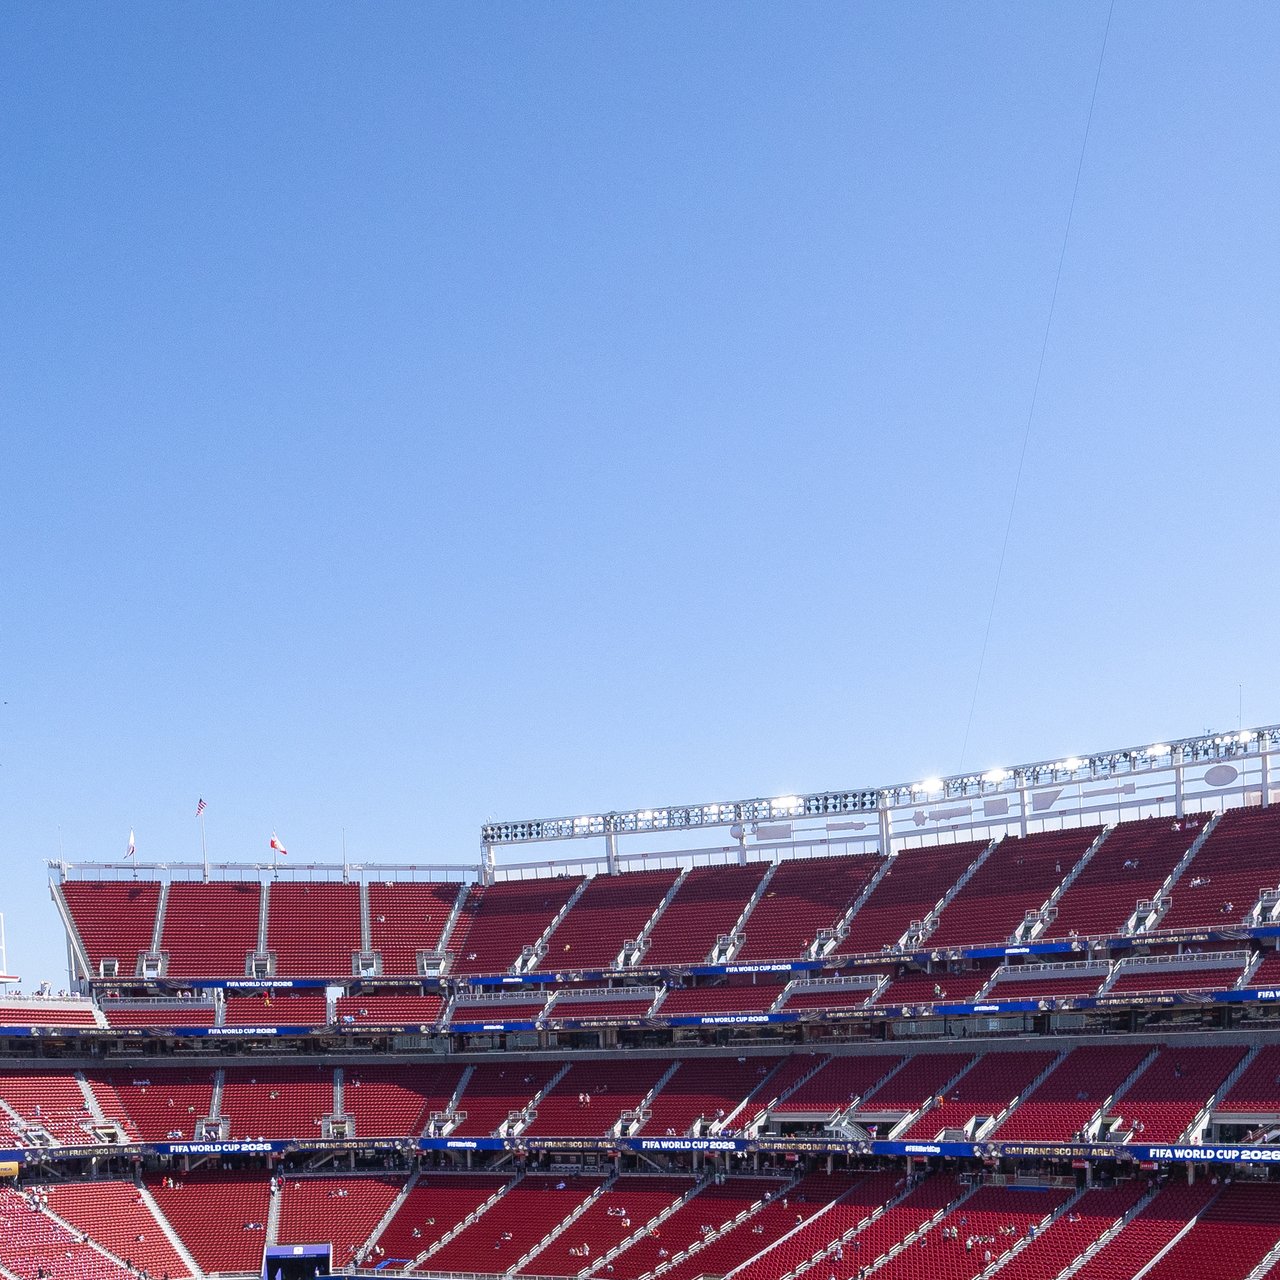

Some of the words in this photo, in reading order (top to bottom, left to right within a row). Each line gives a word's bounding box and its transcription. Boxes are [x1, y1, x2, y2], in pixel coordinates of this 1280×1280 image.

[1258, 991, 1275, 999] FIFA
[748, 1015, 769, 1023] 2026
[170, 1145, 189, 1153] FIFA
[190, 1144, 222, 1153] WORLD
[223, 1144, 240, 1152] CUP
[241, 1143, 272, 1152] 2026
[642, 1141, 661, 1149] FIFA
[661, 1141, 691, 1149] WORLD
[692, 1141, 709, 1149] CUP
[710, 1141, 736, 1150] 2026
[1150, 1148, 1175, 1159] FIFA
[1175, 1149, 1215, 1159] WORLD
[1216, 1149, 1240, 1160] CUP
